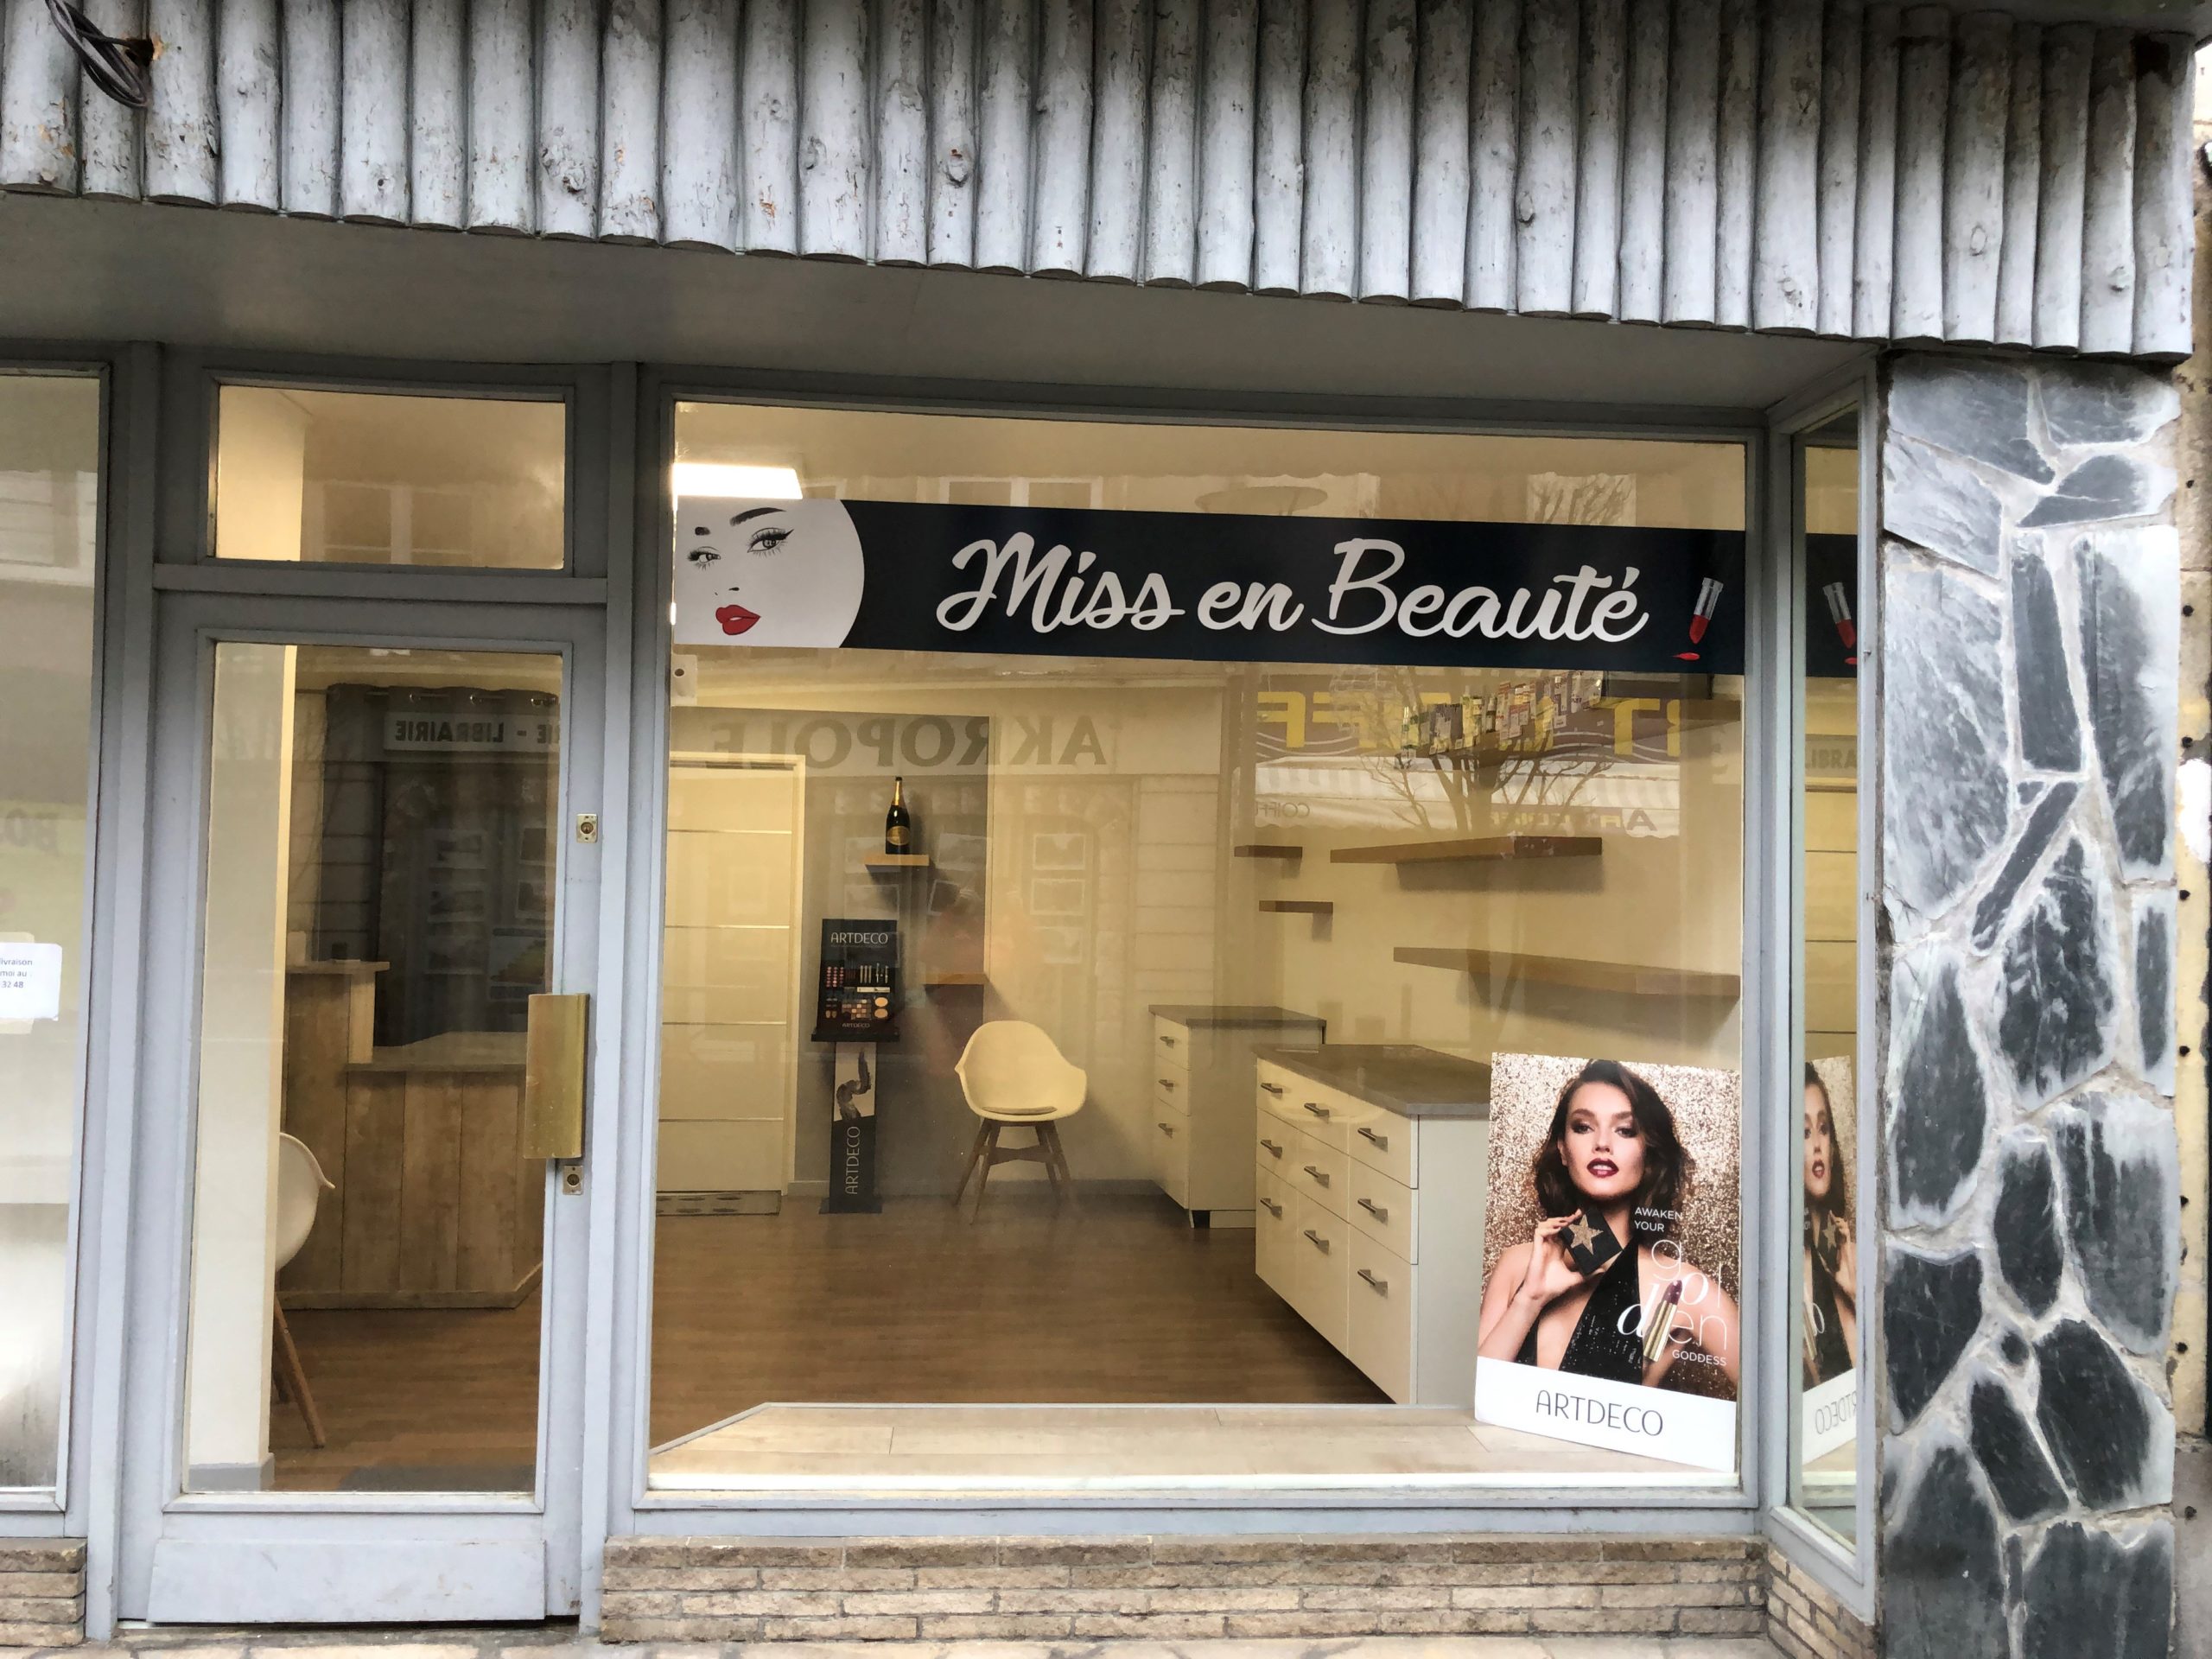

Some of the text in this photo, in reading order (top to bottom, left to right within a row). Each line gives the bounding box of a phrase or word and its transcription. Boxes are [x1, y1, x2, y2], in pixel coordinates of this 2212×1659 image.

[937, 531, 1649, 643] Miss en Beauté
[830, 932, 888, 944] ARTDECO
[845, 1126, 861, 1194] ARTDECO
[1635, 1207, 1683, 1220] AWAKEN
[1635, 1220, 1665, 1232] YOUR
[1672, 1350, 1727, 1366] GODDESS
[1535, 1389, 1663, 1437] ARTDECO
